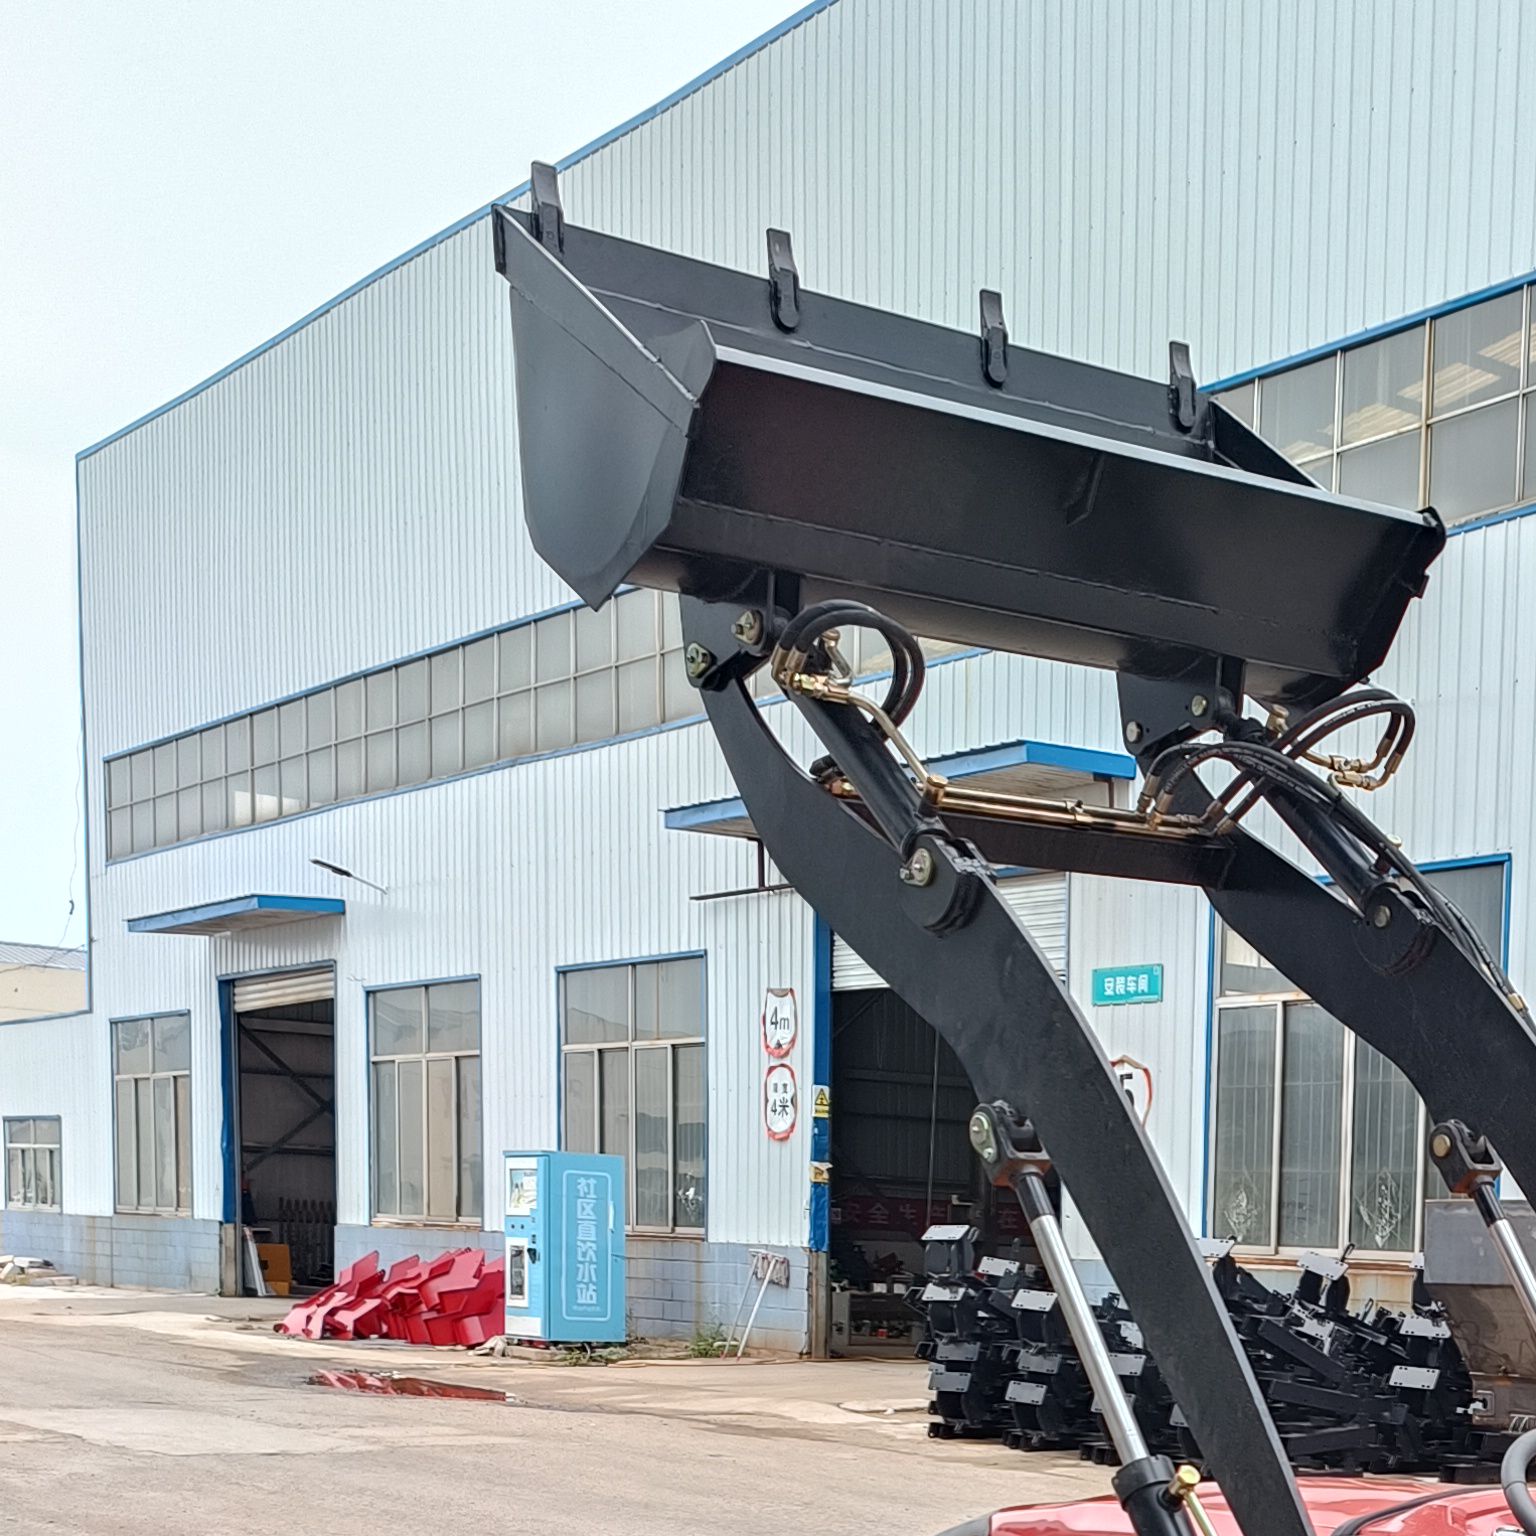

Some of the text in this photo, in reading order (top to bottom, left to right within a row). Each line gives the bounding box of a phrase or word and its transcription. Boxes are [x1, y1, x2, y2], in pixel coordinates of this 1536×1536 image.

[770, 1006, 790, 1030] 4m
[770, 1097, 790, 1118] 4米
[576, 1177, 597, 1304] 社区直饮水站
